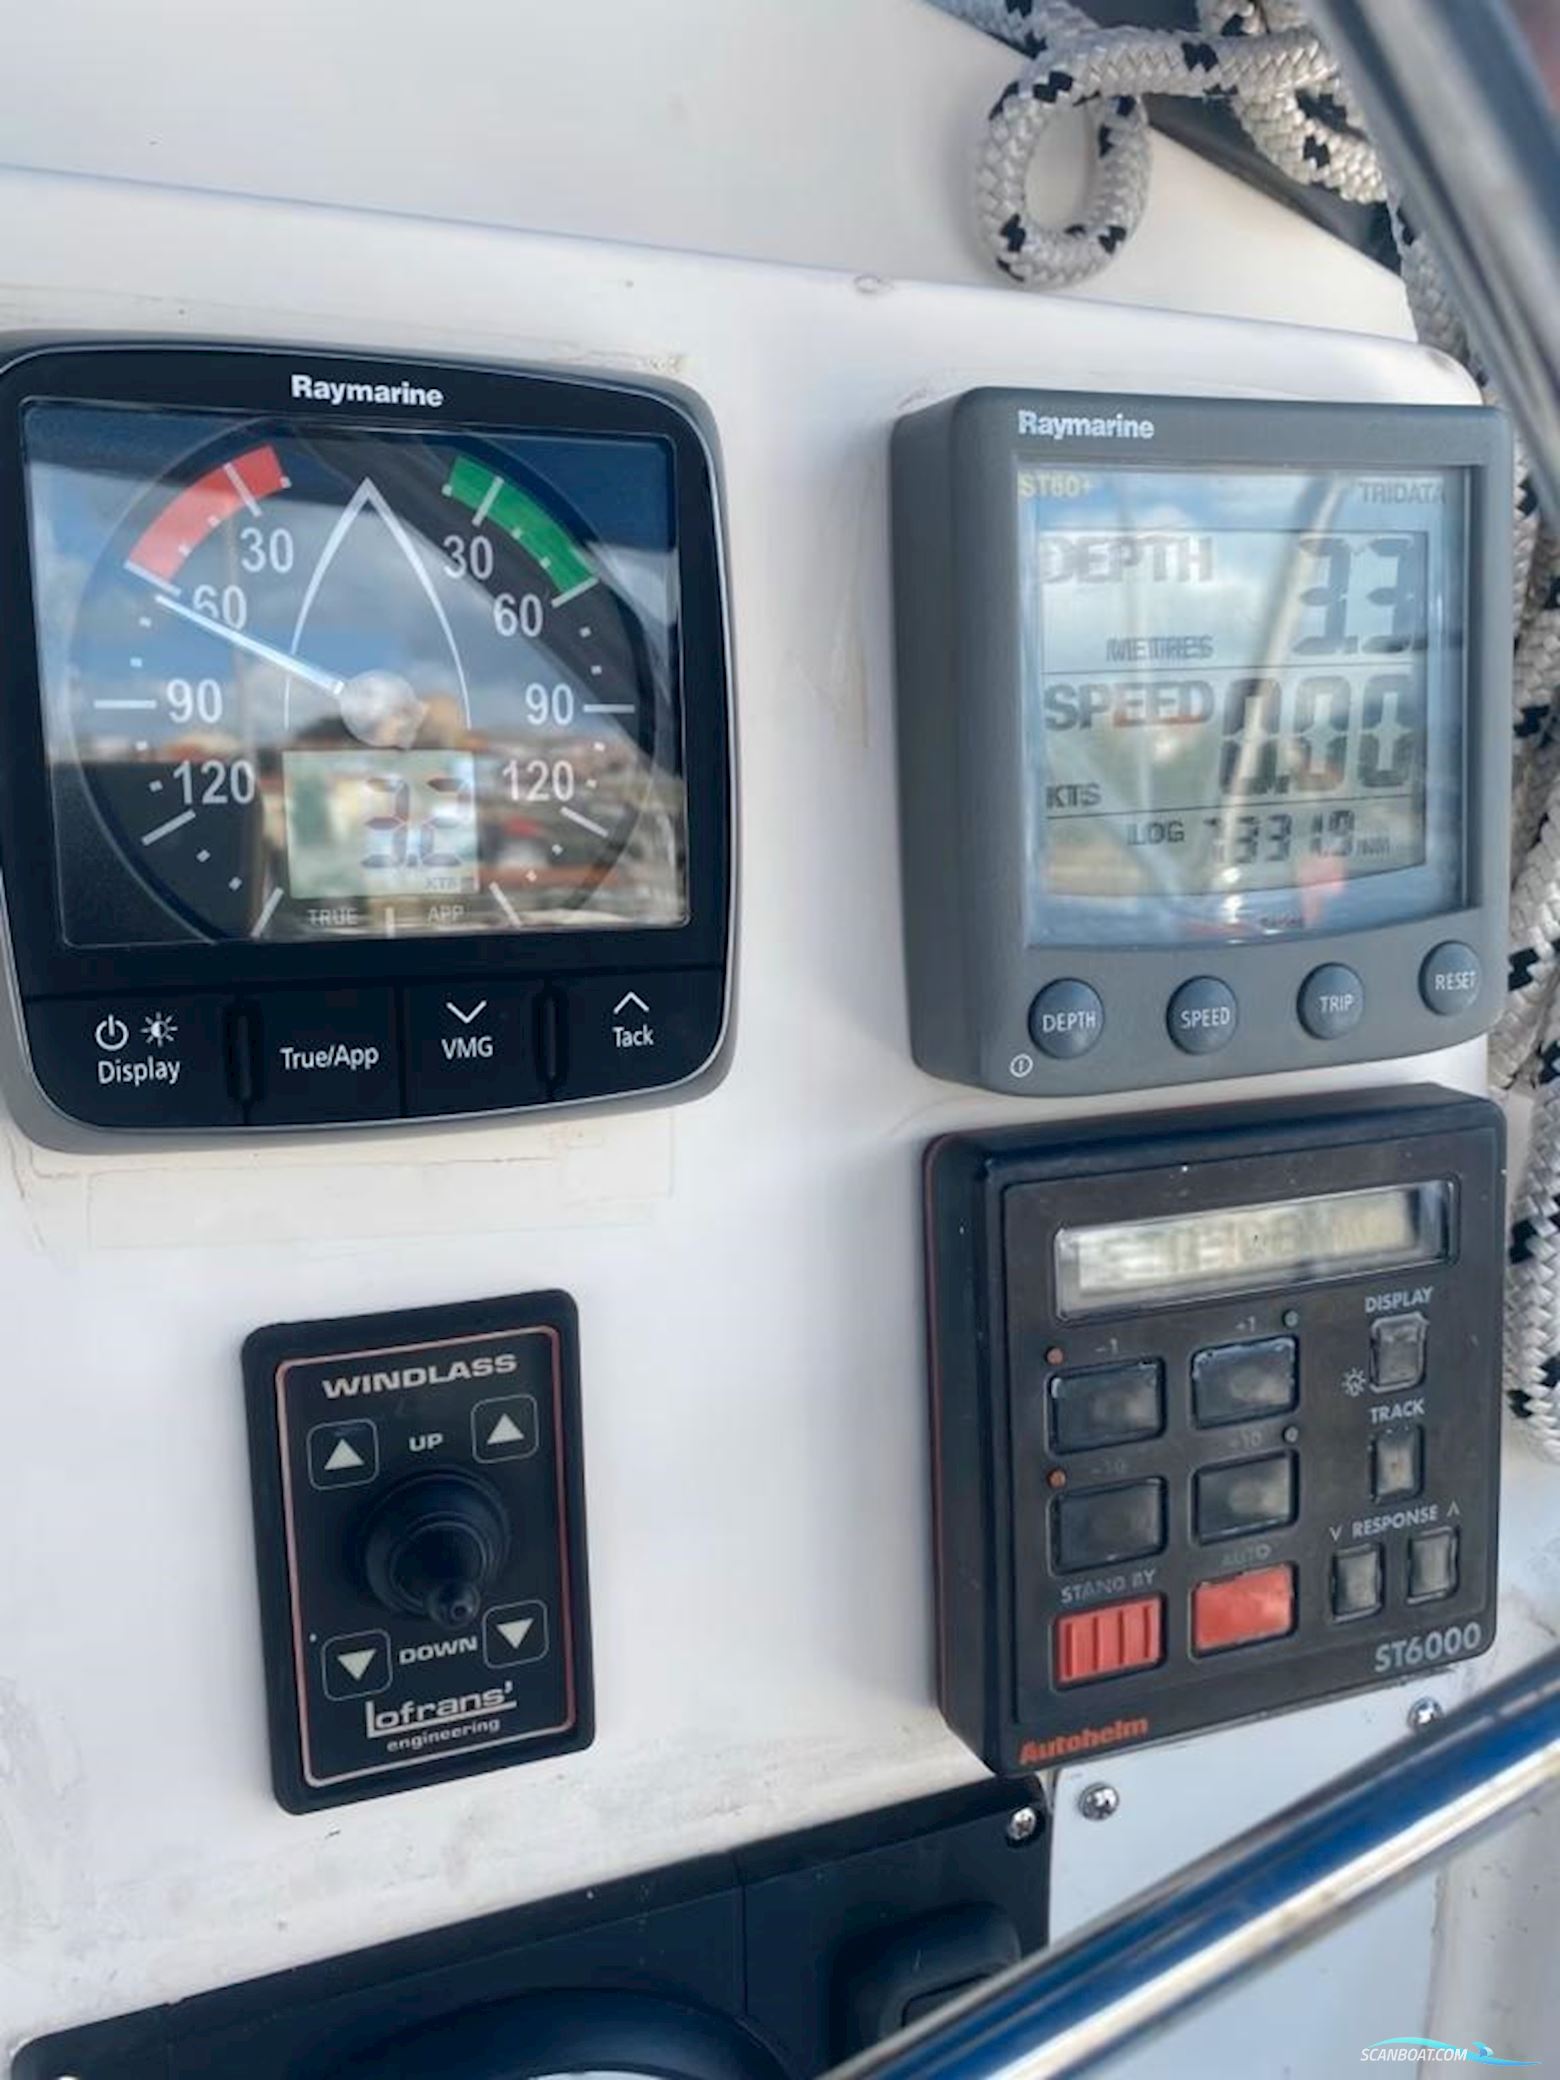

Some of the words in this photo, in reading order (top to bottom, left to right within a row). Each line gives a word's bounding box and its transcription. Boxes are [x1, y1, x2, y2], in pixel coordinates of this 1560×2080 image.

[291, 374, 444, 408] Raymarine
[1017, 410, 1155, 440] Raymarine
[1358, 480, 1446, 505] TRIDATA
[240, 528, 294, 574] 30
[443, 535, 494, 580] 30
[1039, 534, 1214, 584] DEPTH
[195, 585, 248, 631] 60
[494, 593, 544, 638] 60
[1106, 635, 1214, 661] METRES
[167, 678, 223, 725] 90
[525, 683, 575, 726] 90
[1044, 679, 1216, 730] SPEED
[172, 760, 256, 805] 120
[502, 760, 575, 800] 120
[1046, 783, 1101, 808] KTS
[1127, 820, 1185, 846] LOG
[308, 908, 359, 925] TRUE
[428, 905, 464, 922] APP
[1434, 971, 1477, 991] RESET
[1180, 1007, 1230, 1028] SPEED
[1319, 994, 1354, 1013] TRIP
[612, 1025, 654, 1048] Tack
[1042, 1011, 1097, 1032] DEPTH
[280, 1044, 379, 1072] True/App
[441, 1037, 494, 1061] VMG
[98, 1056, 181, 1087] Display
[1365, 1287, 1433, 1314] DISPLAY
[322, 1352, 518, 1400] WINDLASS
[1371, 1399, 1426, 1425] TRACK
[409, 1433, 443, 1452] UP
[1352, 1505, 1439, 1538] RESPONSE
[399, 1636, 477, 1665] DOWN
[1374, 1621, 1482, 1673] ST6000
[386, 1716, 500, 1753] engineering
[1019, 1714, 1149, 1764] Autohelm
